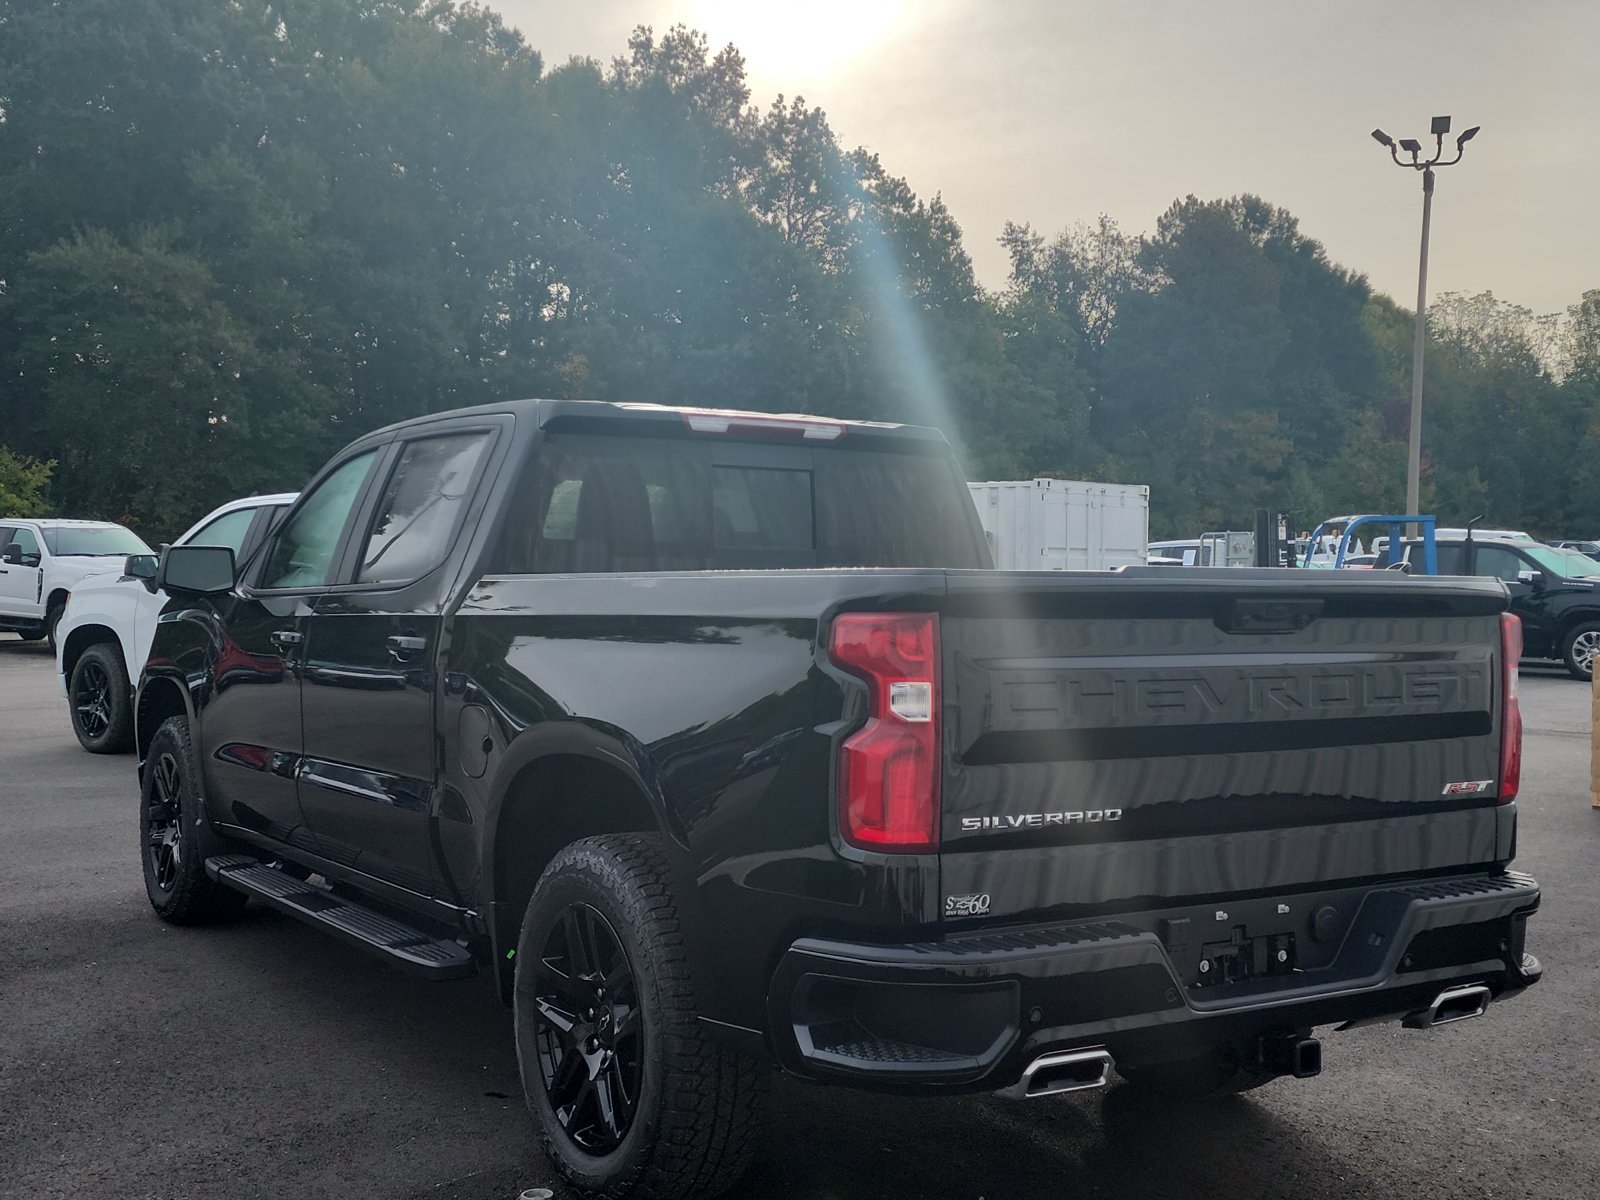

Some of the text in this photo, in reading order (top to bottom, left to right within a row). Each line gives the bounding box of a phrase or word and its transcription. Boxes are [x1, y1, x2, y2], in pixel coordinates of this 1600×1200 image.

[1001, 670, 1481, 720] CHEVROLET
[1442, 780, 1494, 795] RST
[961, 808, 1123, 831] SILVERADO
[969, 894, 991, 914] 60
